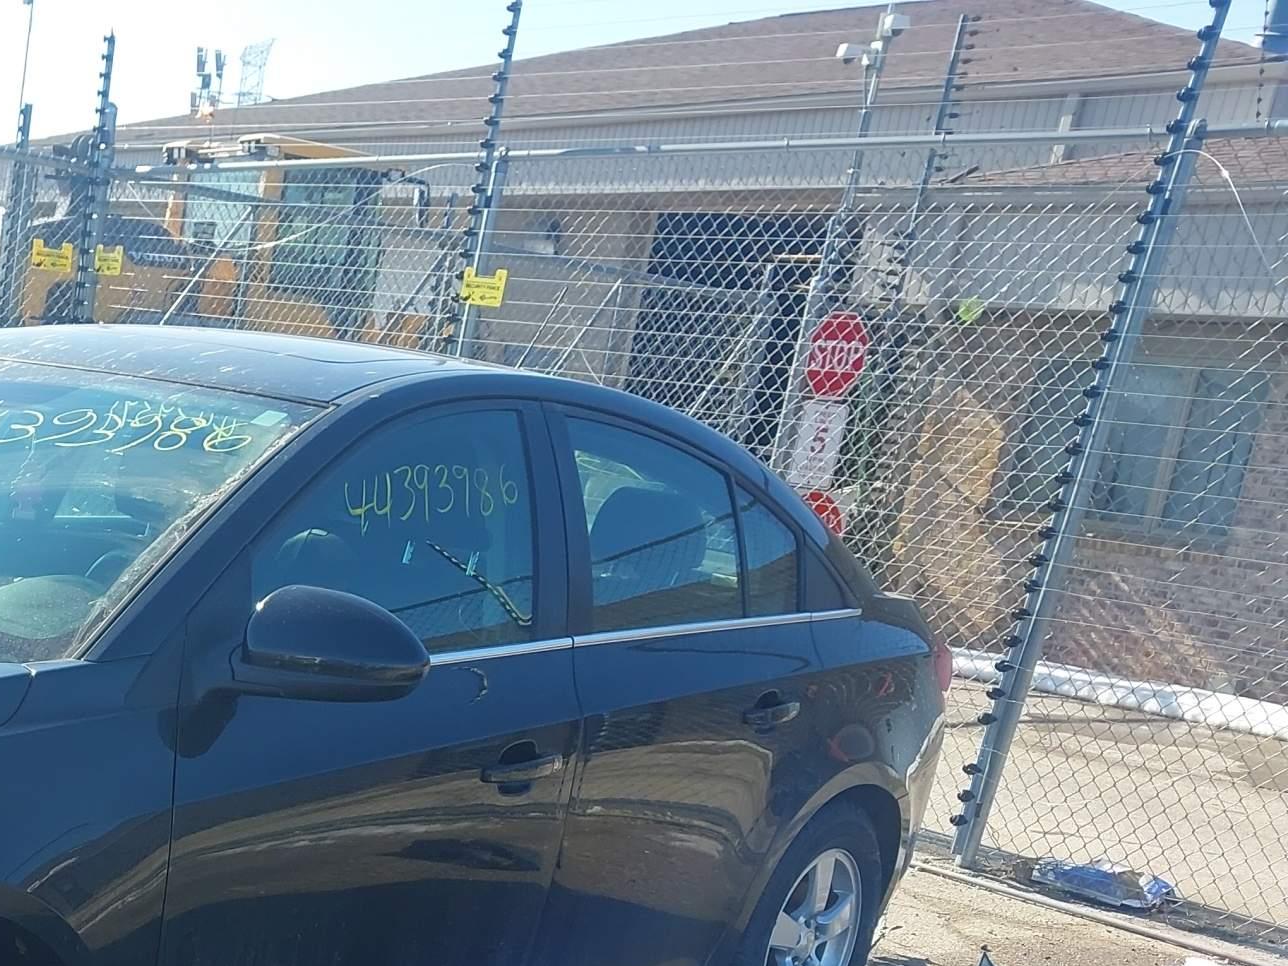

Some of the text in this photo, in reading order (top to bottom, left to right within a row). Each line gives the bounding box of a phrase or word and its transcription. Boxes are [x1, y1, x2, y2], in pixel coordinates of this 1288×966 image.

[810, 339, 865, 371] STOP
[810, 426, 829, 454] 5
[344, 464, 519, 534] 44393986
